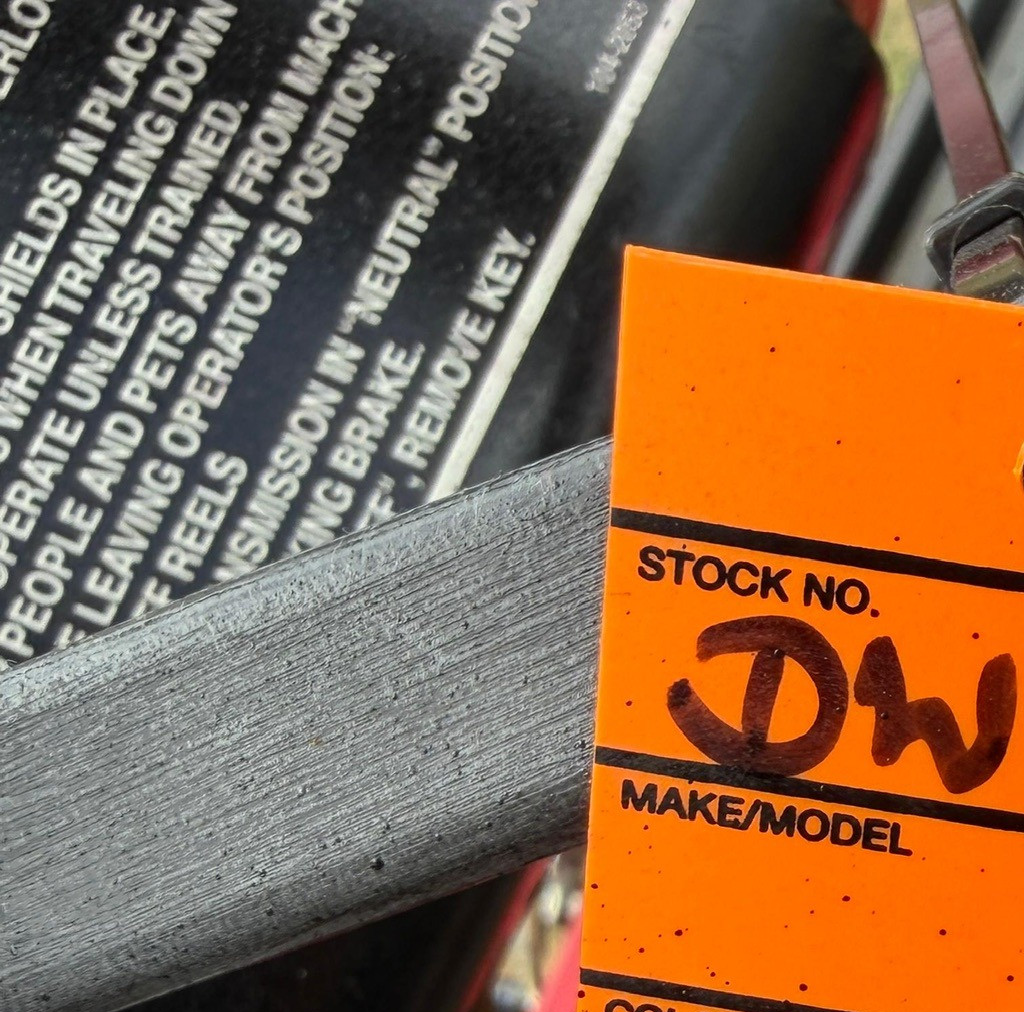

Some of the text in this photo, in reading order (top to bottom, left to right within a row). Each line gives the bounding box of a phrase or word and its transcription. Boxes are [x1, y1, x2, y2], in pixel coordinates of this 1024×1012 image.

[55, 128, 106, 177] IN
[77, 3, 176, 133] PLACE.
[0, 0, 238, 431] WHEN TRAVELING DOWN
[56, 258, 162, 412] UNLESS
[132, 100, 249, 260] TRAINED.
[315, 333, 366, 384] IN
[433, 0, 538, 142] POSITIO
[0, 496, 103, 657] PEOPLE
[77, 411, 144, 502] AND
[118, 309, 197, 414] PETS
[172, 198, 250, 313] AWAY
[224, 90, 309, 205] FROM
[72, 43, 395, 627] LEAVING OPERATOR'S POSITION:
[327, 340, 426, 481] BRAKE.
[390, 307, 497, 470] REMOVE
[466, 226, 537, 313] KEY.
[157, 451, 248, 582] REELS
[637, 545, 880, 618] STOCK NO.
[620, 779, 913, 857] MAKE/MODEL
